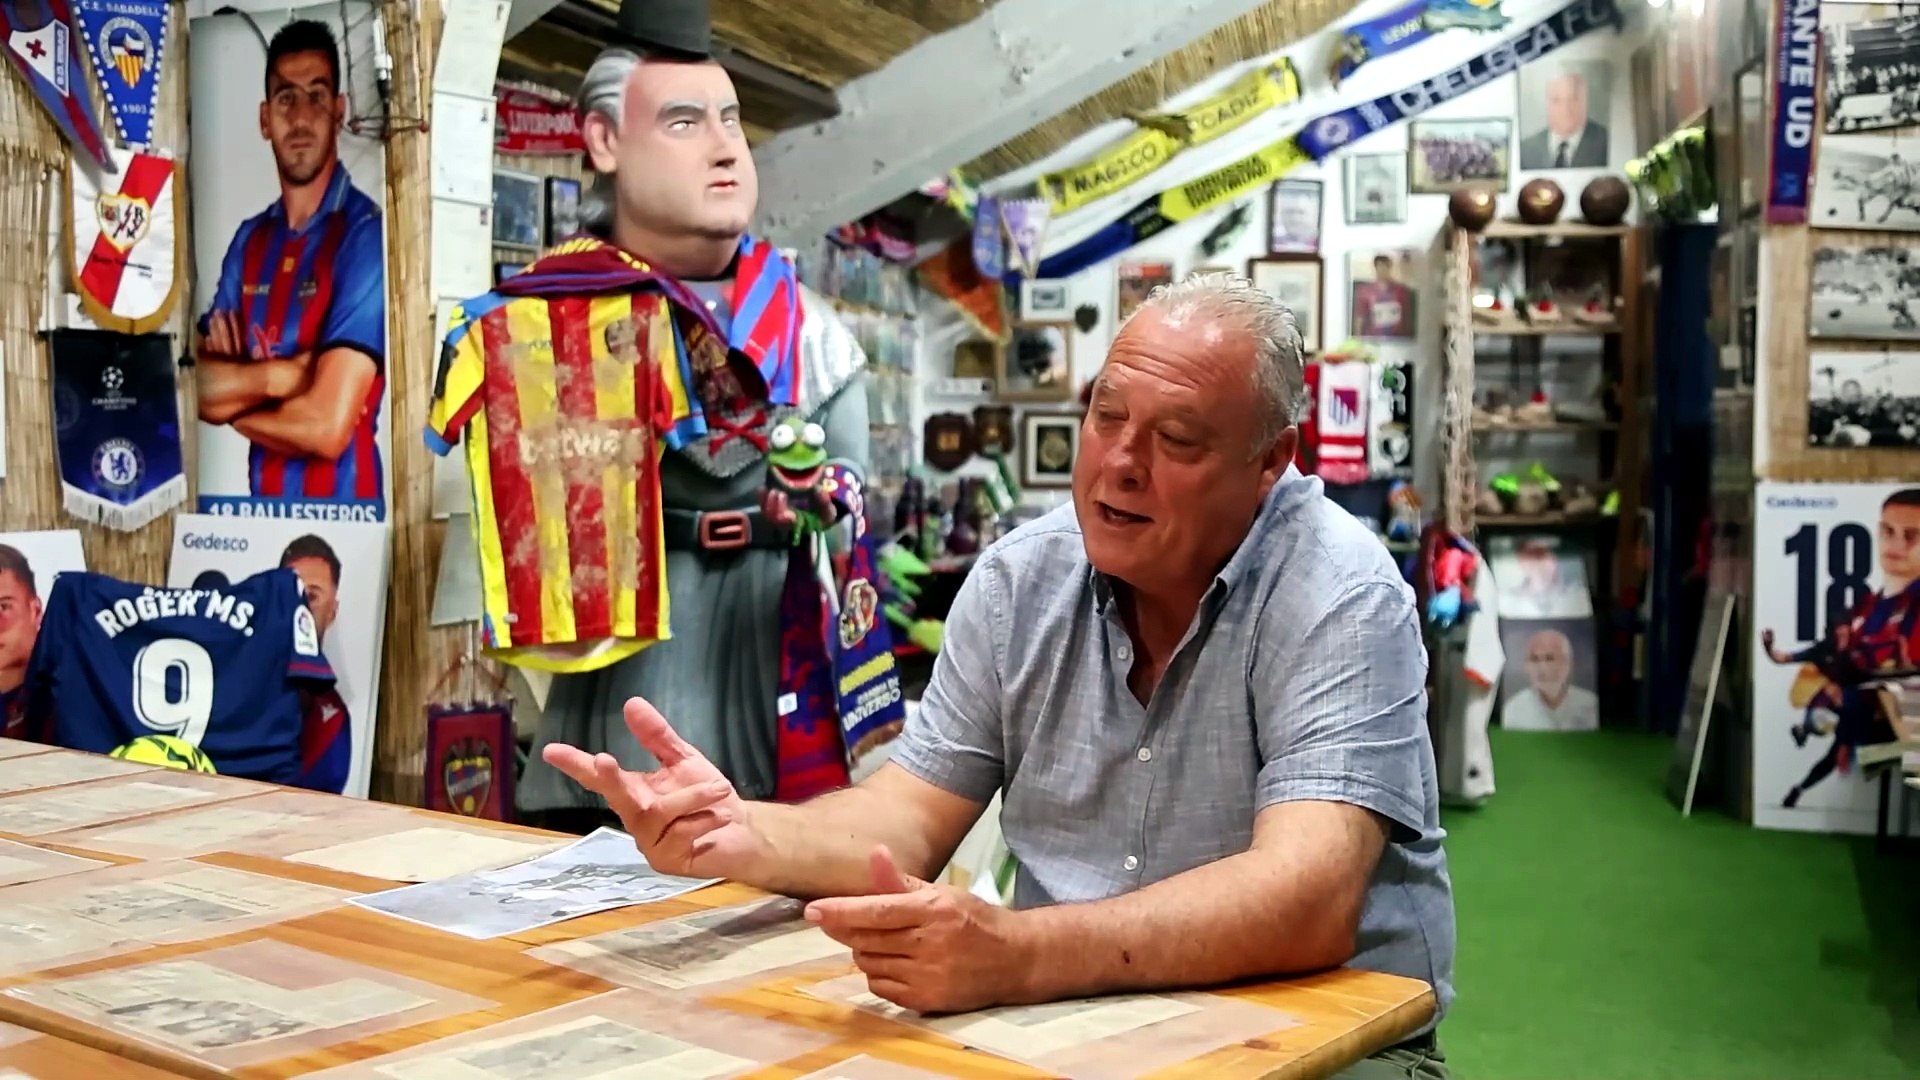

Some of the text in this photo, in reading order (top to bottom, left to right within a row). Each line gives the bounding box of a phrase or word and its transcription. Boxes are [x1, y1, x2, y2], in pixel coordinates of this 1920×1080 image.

[106, 3, 162, 17] SABADELL
[508, 110, 581, 135] LIVERPOOL
[1784, 96, 1815, 149] UD
[239, 503, 378, 522] BALLESTEROS
[181, 532, 249, 552] Gedesco
[1784, 522, 1873, 642] 18
[95, 589, 198, 640] ROGER
[132, 637, 215, 748] 9
